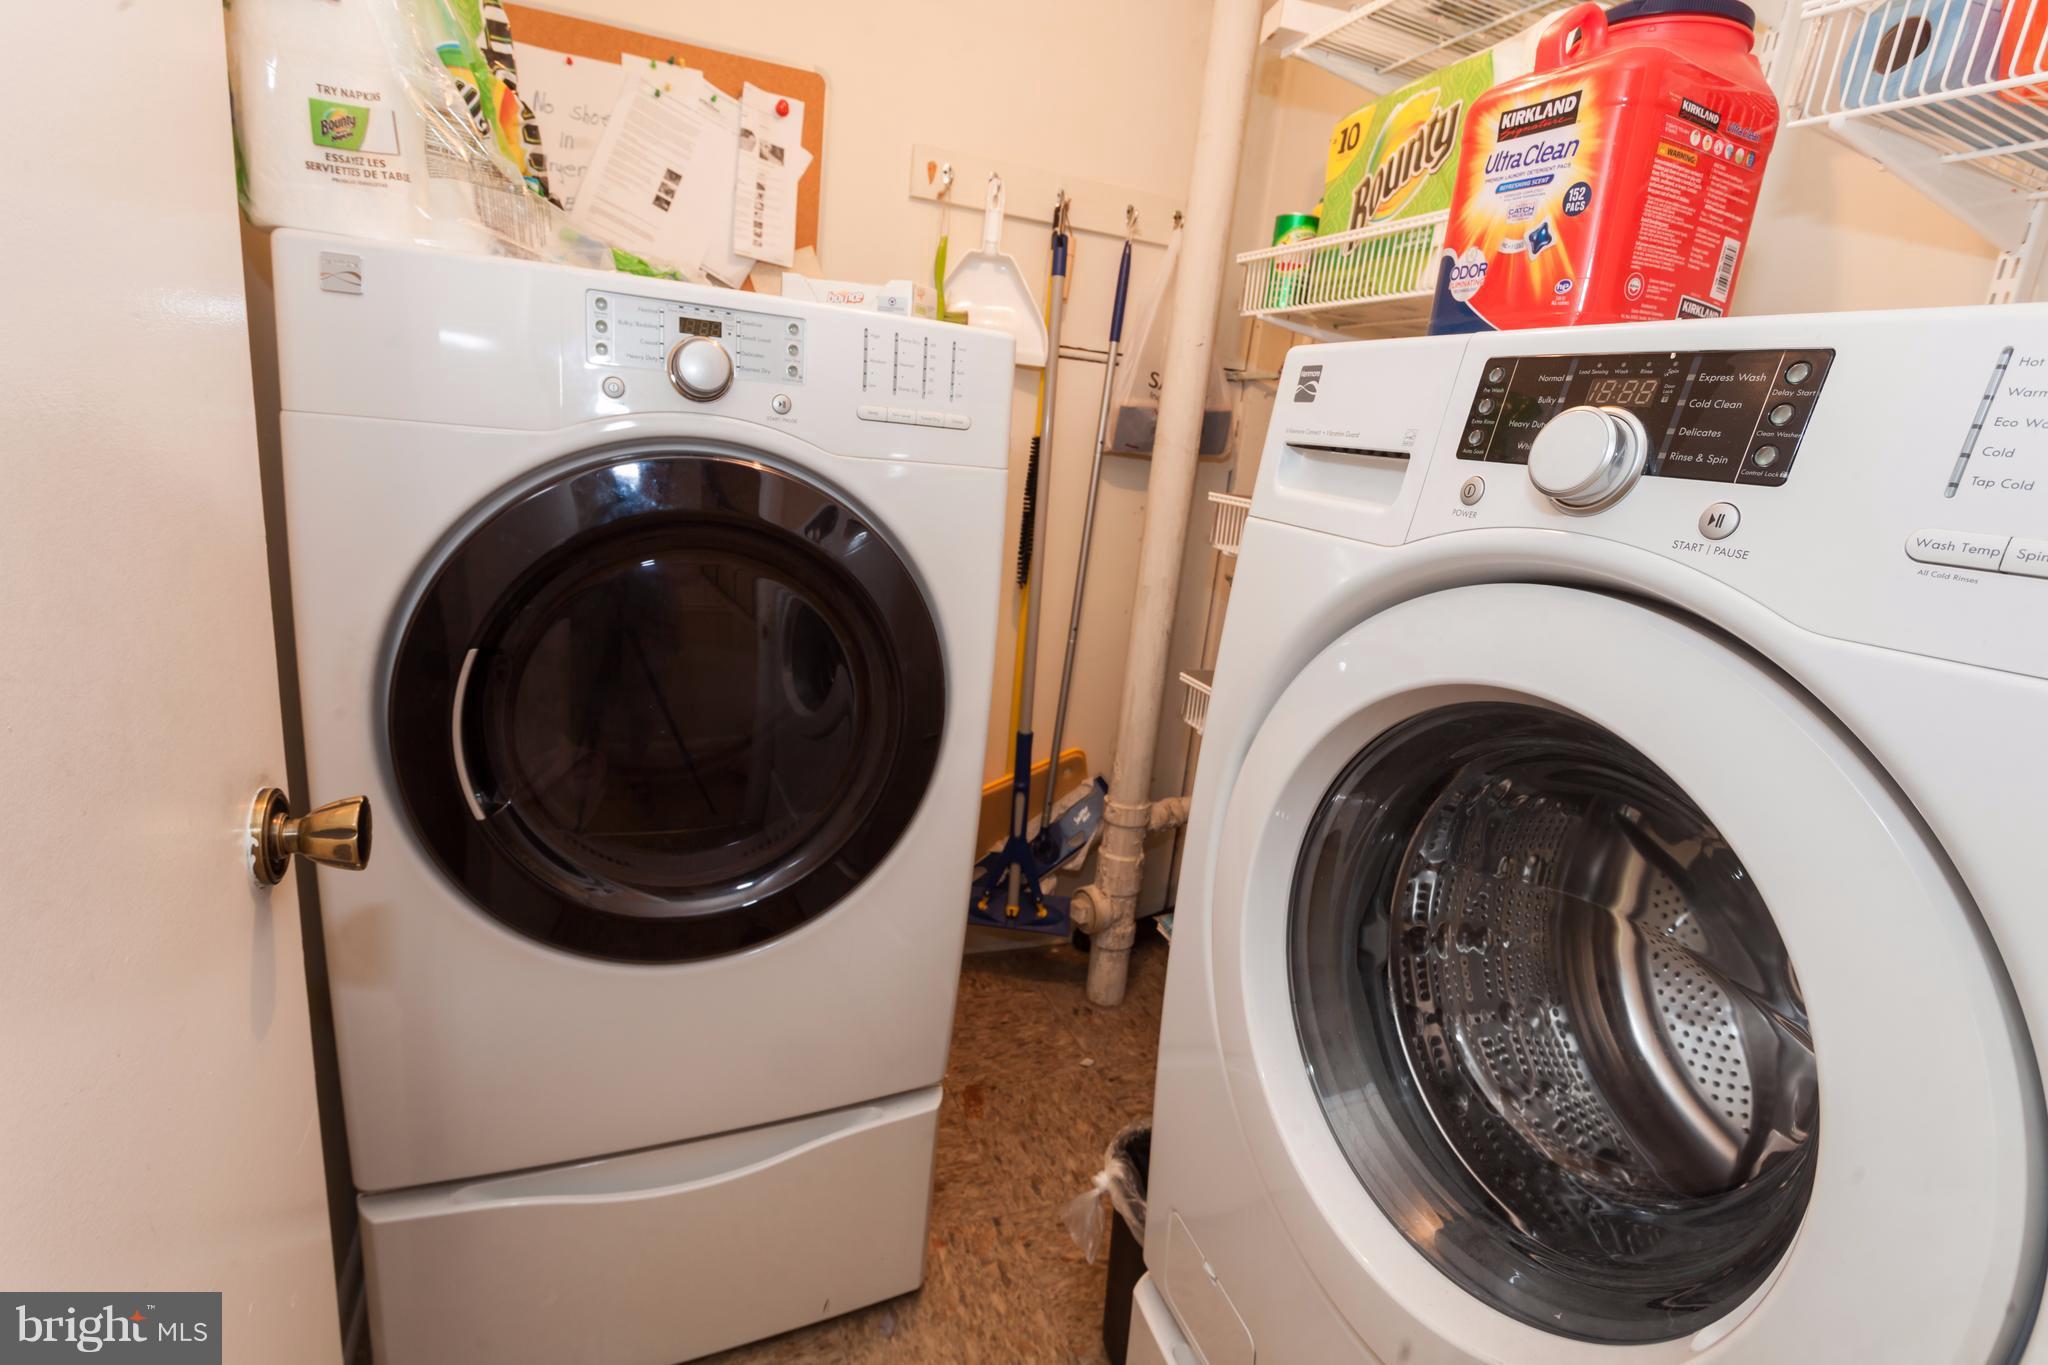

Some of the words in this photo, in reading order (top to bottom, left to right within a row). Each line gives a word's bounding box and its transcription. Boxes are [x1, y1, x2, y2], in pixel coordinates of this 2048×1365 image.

[316, 83, 338, 95] TRY
[533, 90, 554, 114] No
[1501, 95, 1578, 129] KIRKLAND
[1682, 99, 1720, 124] KIRKLAND
[320, 114, 356, 137] Bounty
[1337, 121, 1361, 155] 10
[325, 152, 366, 166] ESSAYEZ
[367, 157, 386, 168] LES
[1485, 150, 1522, 174] Ultra
[1523, 139, 1580, 166] Clean
[305, 160, 361, 177] SERVIETTES
[363, 169, 378, 179] DE
[1346, 101, 1463, 254] Bounty
[1568, 186, 1586, 201] 152
[1508, 205, 1535, 215] CATCH
[1565, 201, 1586, 213] PACS
[1450, 262, 1488, 280] ODOR
[1682, 300, 1719, 319] KIRKLAND
[2018, 356, 2045, 367] Hot
[1699, 373, 1735, 383] Express
[1738, 373, 1767, 382] Wash
[1772, 389, 1795, 397] Delay
[1797, 389, 1816, 397] Start
[1537, 396, 1557, 406] Bulky
[1689, 399, 1710, 409] Cold
[1714, 400, 1743, 409] Clean
[1509, 419, 1531, 429] Heavy
[1994, 416, 2019, 427] Eco
[1678, 427, 1722, 438] Delicates
[1669, 452, 1694, 462] Rinse
[1695, 453, 1704, 462] &
[1706, 453, 1729, 465] Spin
[1982, 446, 2015, 459] Cold
[1740, 469, 1763, 477] Control
[1971, 476, 1996, 489] Tap
[2001, 478, 2035, 492] Cold
[1452, 508, 1478, 519] POWER
[1672, 540, 1705, 554] START
[1713, 546, 1750, 560] PAUSE
[1915, 537, 1956, 551] Wash
[1960, 542, 2001, 559] Temp
[2016, 548, 2048, 563] Spin
[1917, 569, 1928, 577] All
[1930, 570, 1950, 581] Cold
[1953, 574, 1979, 585] Rinses
